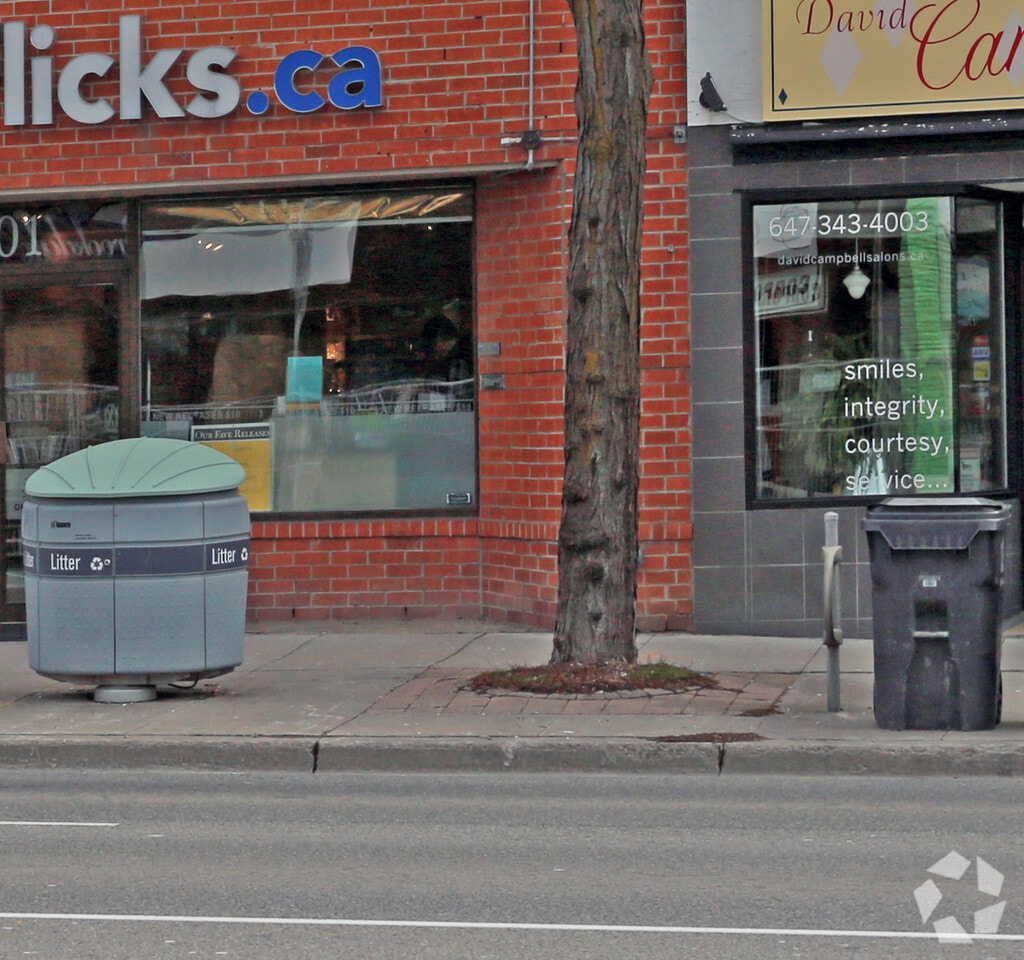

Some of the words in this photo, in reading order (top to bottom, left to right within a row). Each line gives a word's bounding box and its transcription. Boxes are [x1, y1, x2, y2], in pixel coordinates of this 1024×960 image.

[768, 211, 928, 237] 647-343-4003
[777, 251, 924, 266] davidcampbellsalons.ca
[844, 359, 924, 381] smiles,
[844, 395, 945, 420] integrity,
[195, 430, 213, 439] OUR
[234, 428, 271, 438] RELEASES
[844, 436, 950, 456] courtesy,
[50, 552, 81, 571] Litter
[211, 547, 236, 565] Litter
